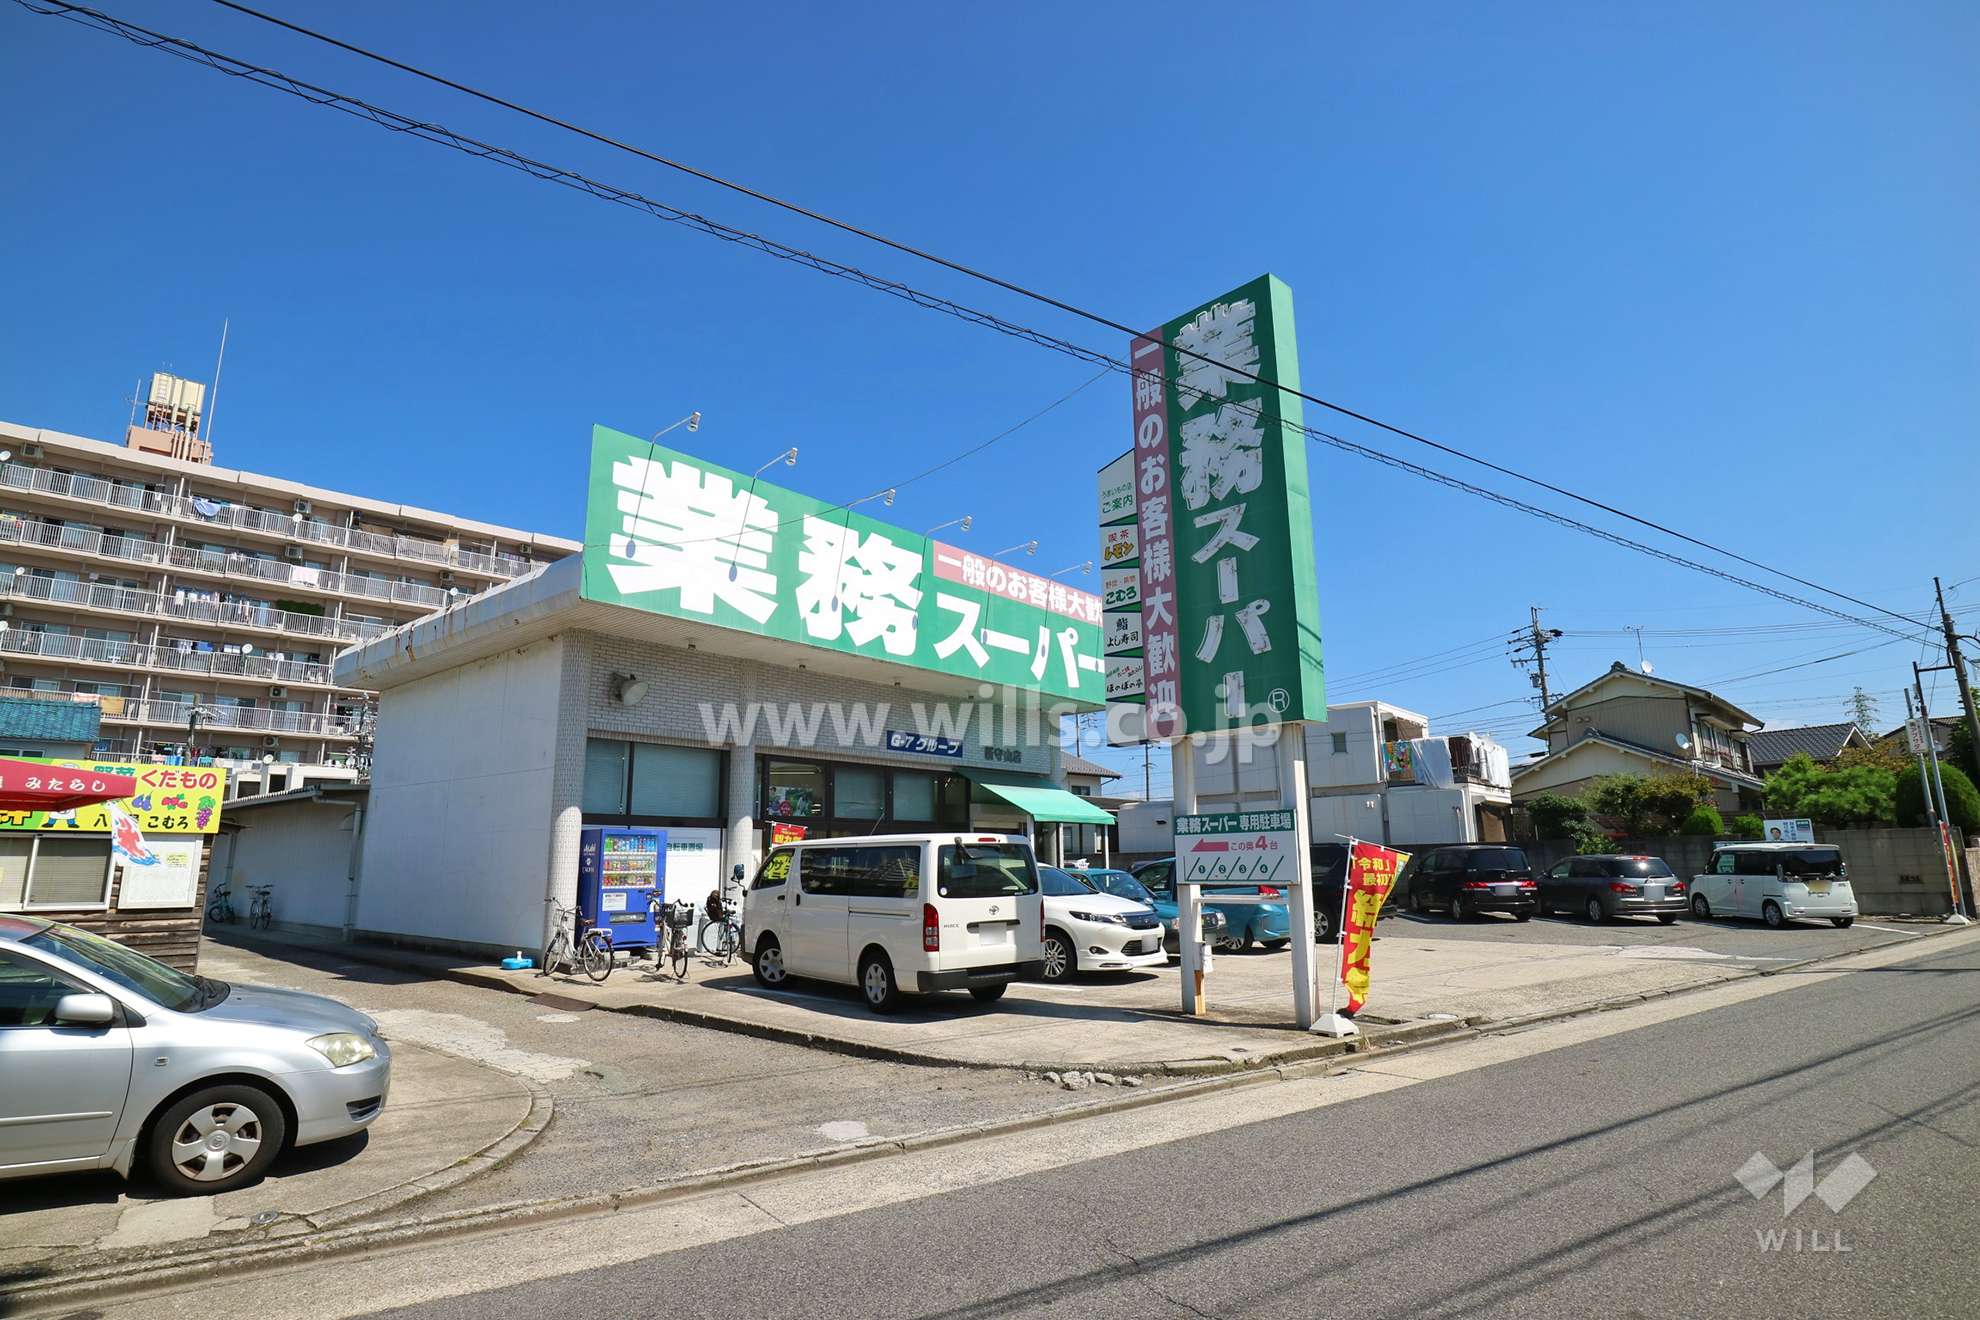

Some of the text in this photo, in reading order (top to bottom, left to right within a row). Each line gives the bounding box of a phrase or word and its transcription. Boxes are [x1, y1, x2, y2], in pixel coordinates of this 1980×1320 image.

[1102, 494, 1133, 514] ご案内
[1174, 298, 1273, 718] 業務スーパー
[1135, 341, 1178, 720] 一般のお客様大歓迎
[1104, 542, 1135, 561] レモン
[606, 455, 1104, 689] 業務スーパー
[1106, 586, 1137, 604] こむろ
[1107, 631, 1139, 647] よし寿司
[915, 737, 960, 754] グループ
[25, 777, 106, 792] みたらし
[141, 769, 218, 789] くだもの
[147, 815, 189, 829] こむろ
[1176, 813, 1292, 834] 業務スーパー 専用駐車場
